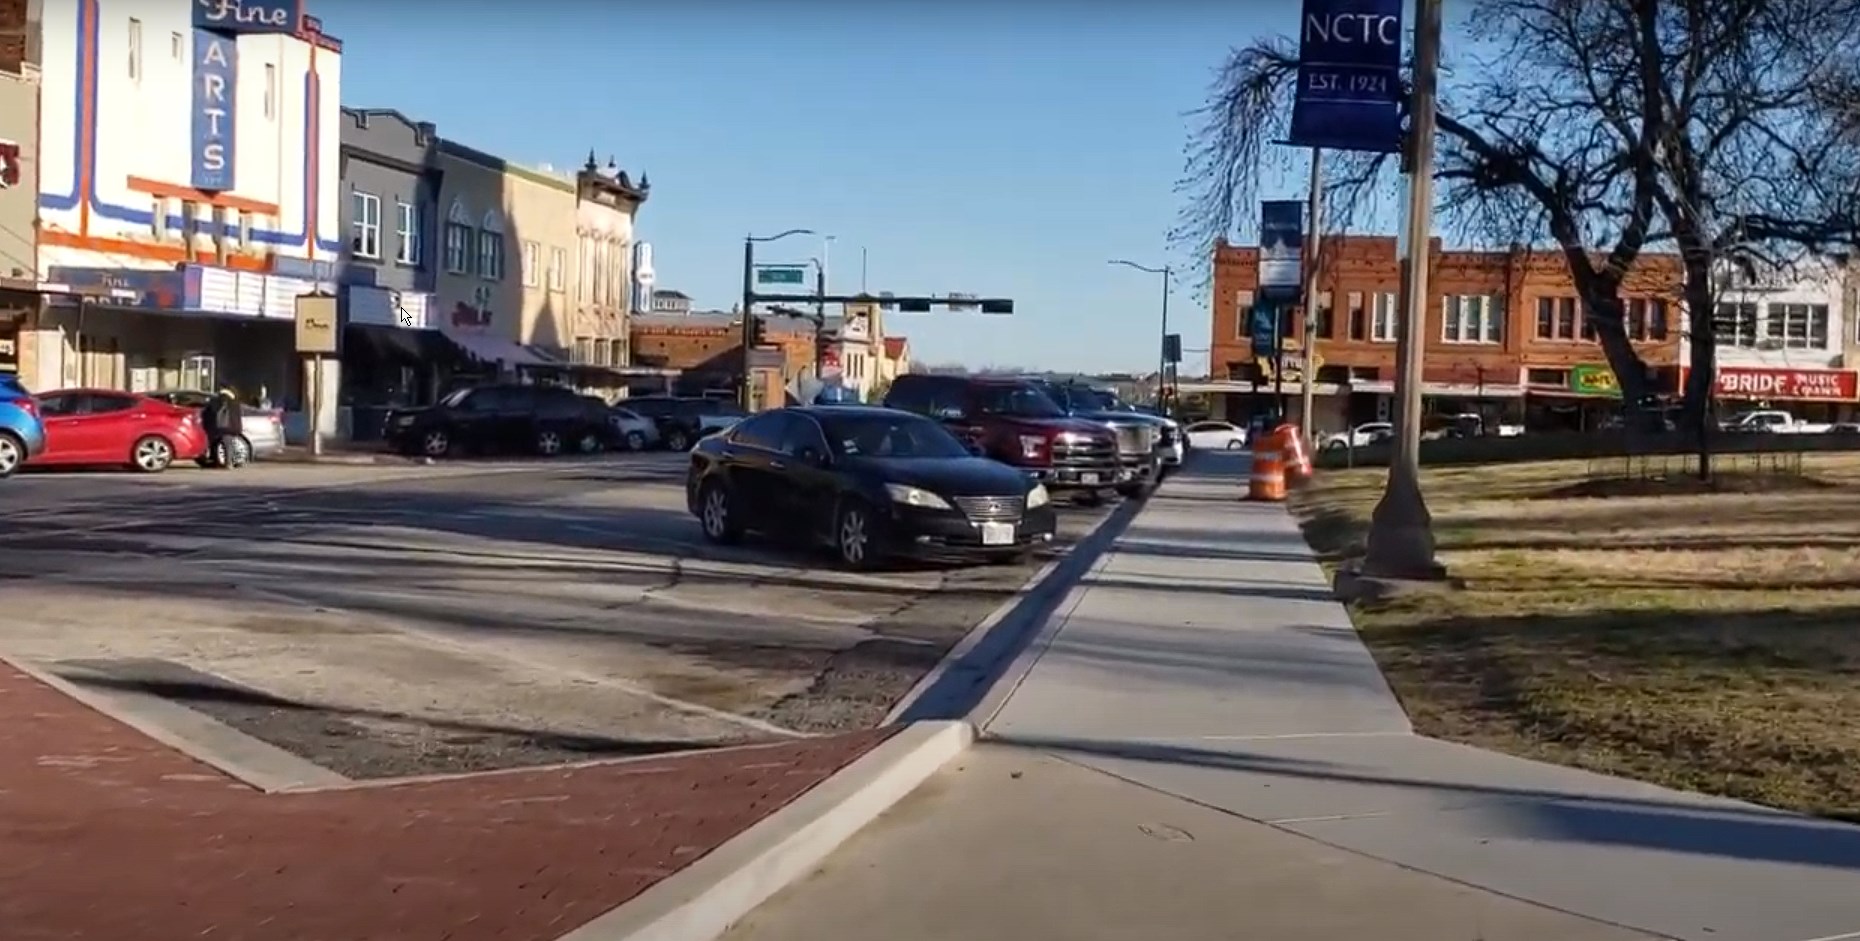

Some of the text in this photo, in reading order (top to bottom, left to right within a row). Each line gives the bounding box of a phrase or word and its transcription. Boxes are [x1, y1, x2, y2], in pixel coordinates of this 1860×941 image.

[199, 0, 288, 26] Fine
[1305, 13, 1398, 45] NCTC
[1308, 73, 1342, 91] EST.
[203, 40, 227, 171] ARTS
[1793, 374, 1839, 387] MUSIC
